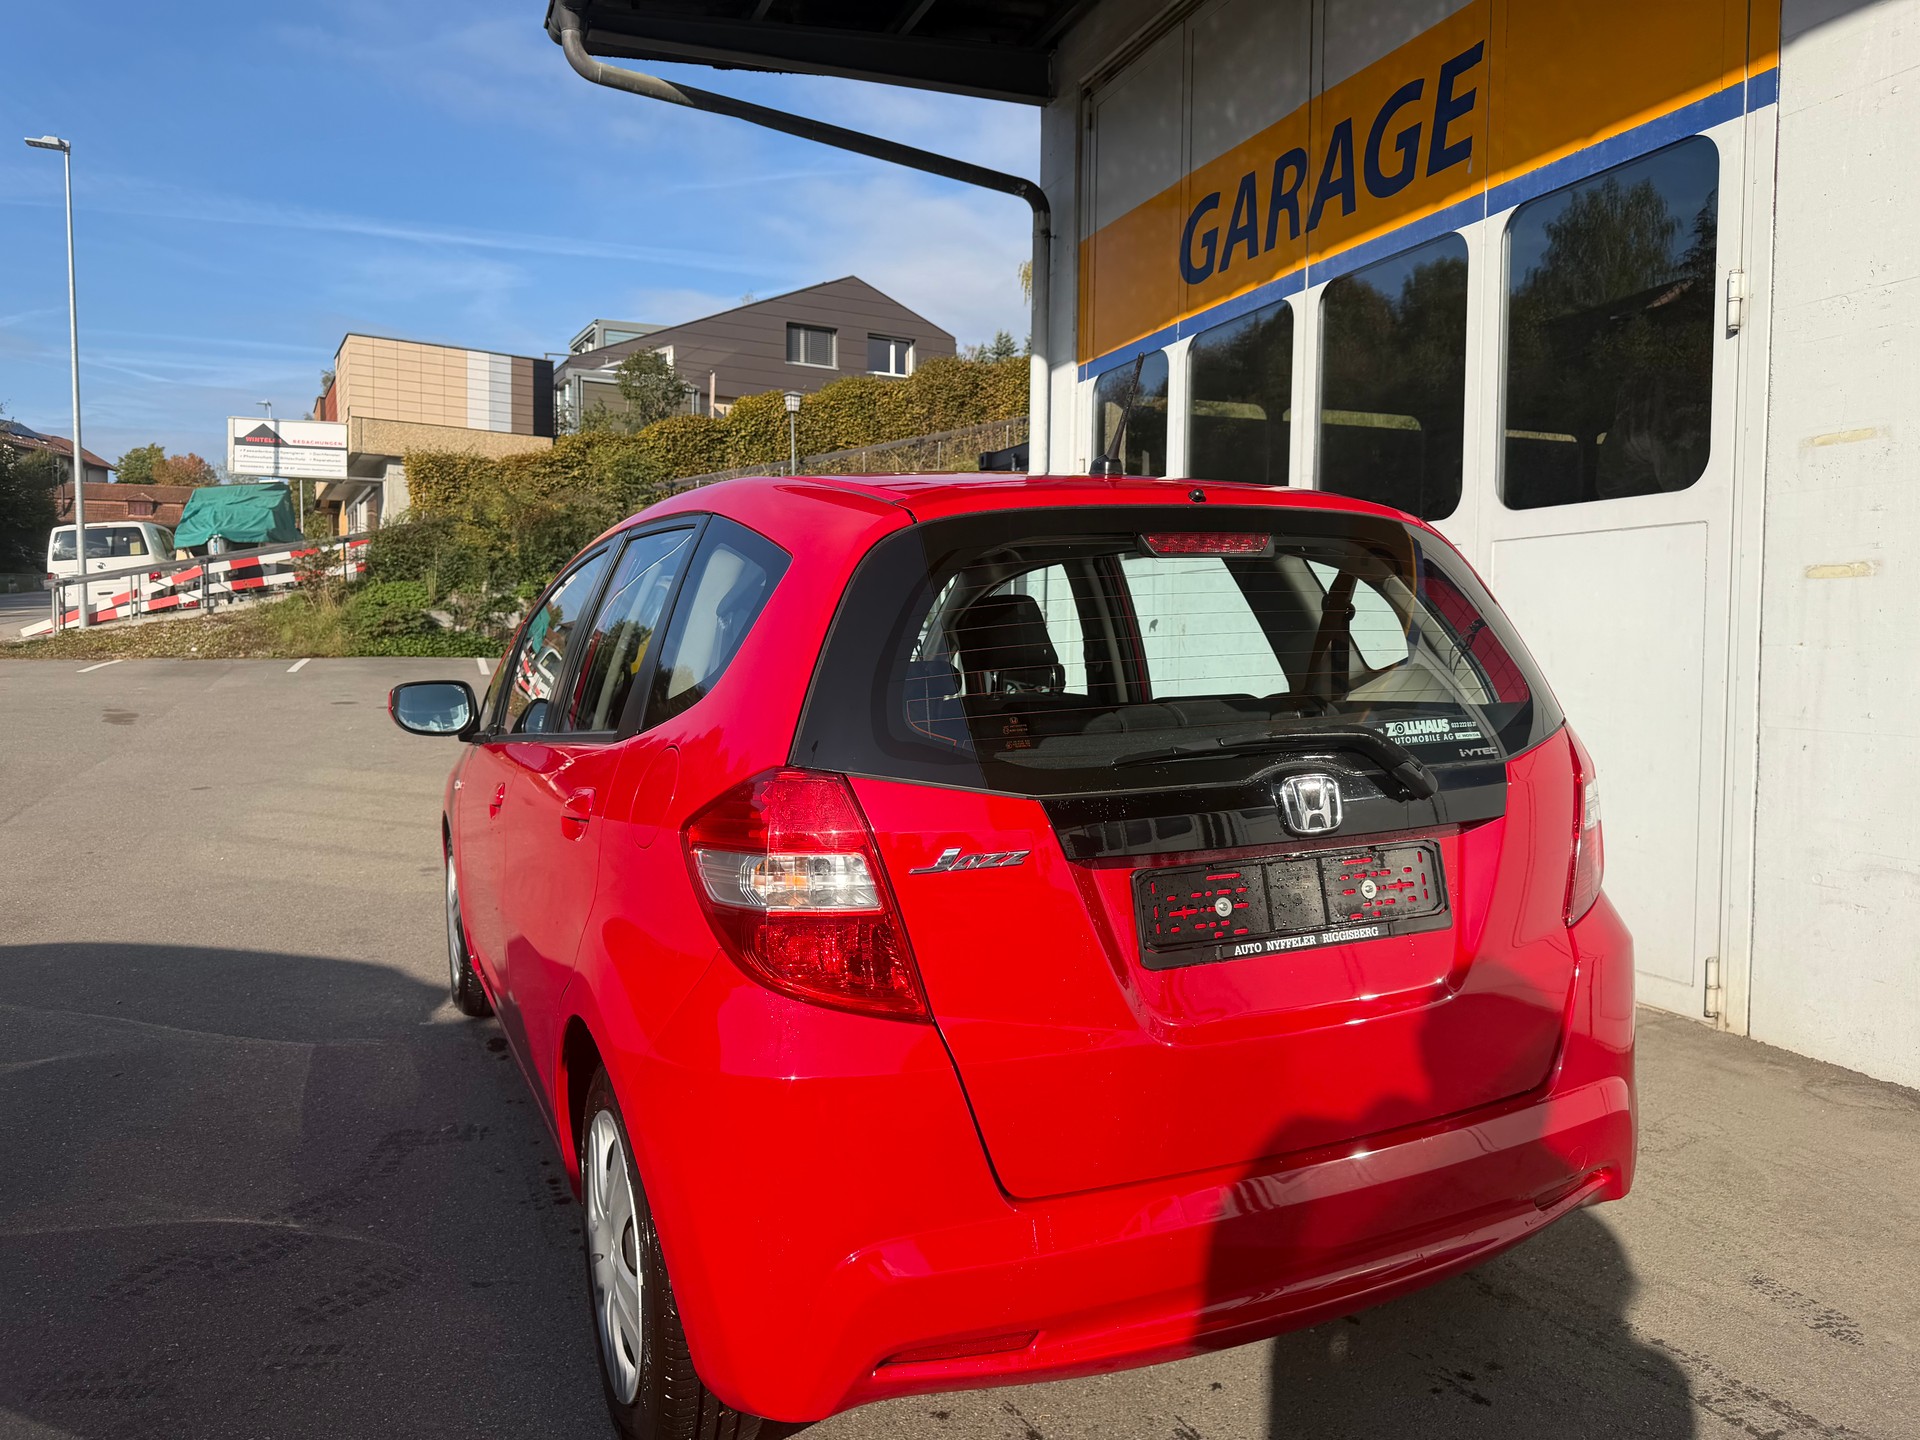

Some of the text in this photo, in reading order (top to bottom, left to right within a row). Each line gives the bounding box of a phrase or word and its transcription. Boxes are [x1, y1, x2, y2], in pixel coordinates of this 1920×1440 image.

[1179, 39, 1485, 286] GARAGE
[245, 436, 282, 444] WINTEL
[1385, 718, 1450, 737] ZOLLHAUS
[1390, 732, 1454, 745] UTOMOBILE AG
[1234, 926, 1379, 956] AUTO NYFFELER RIGGISBERG
